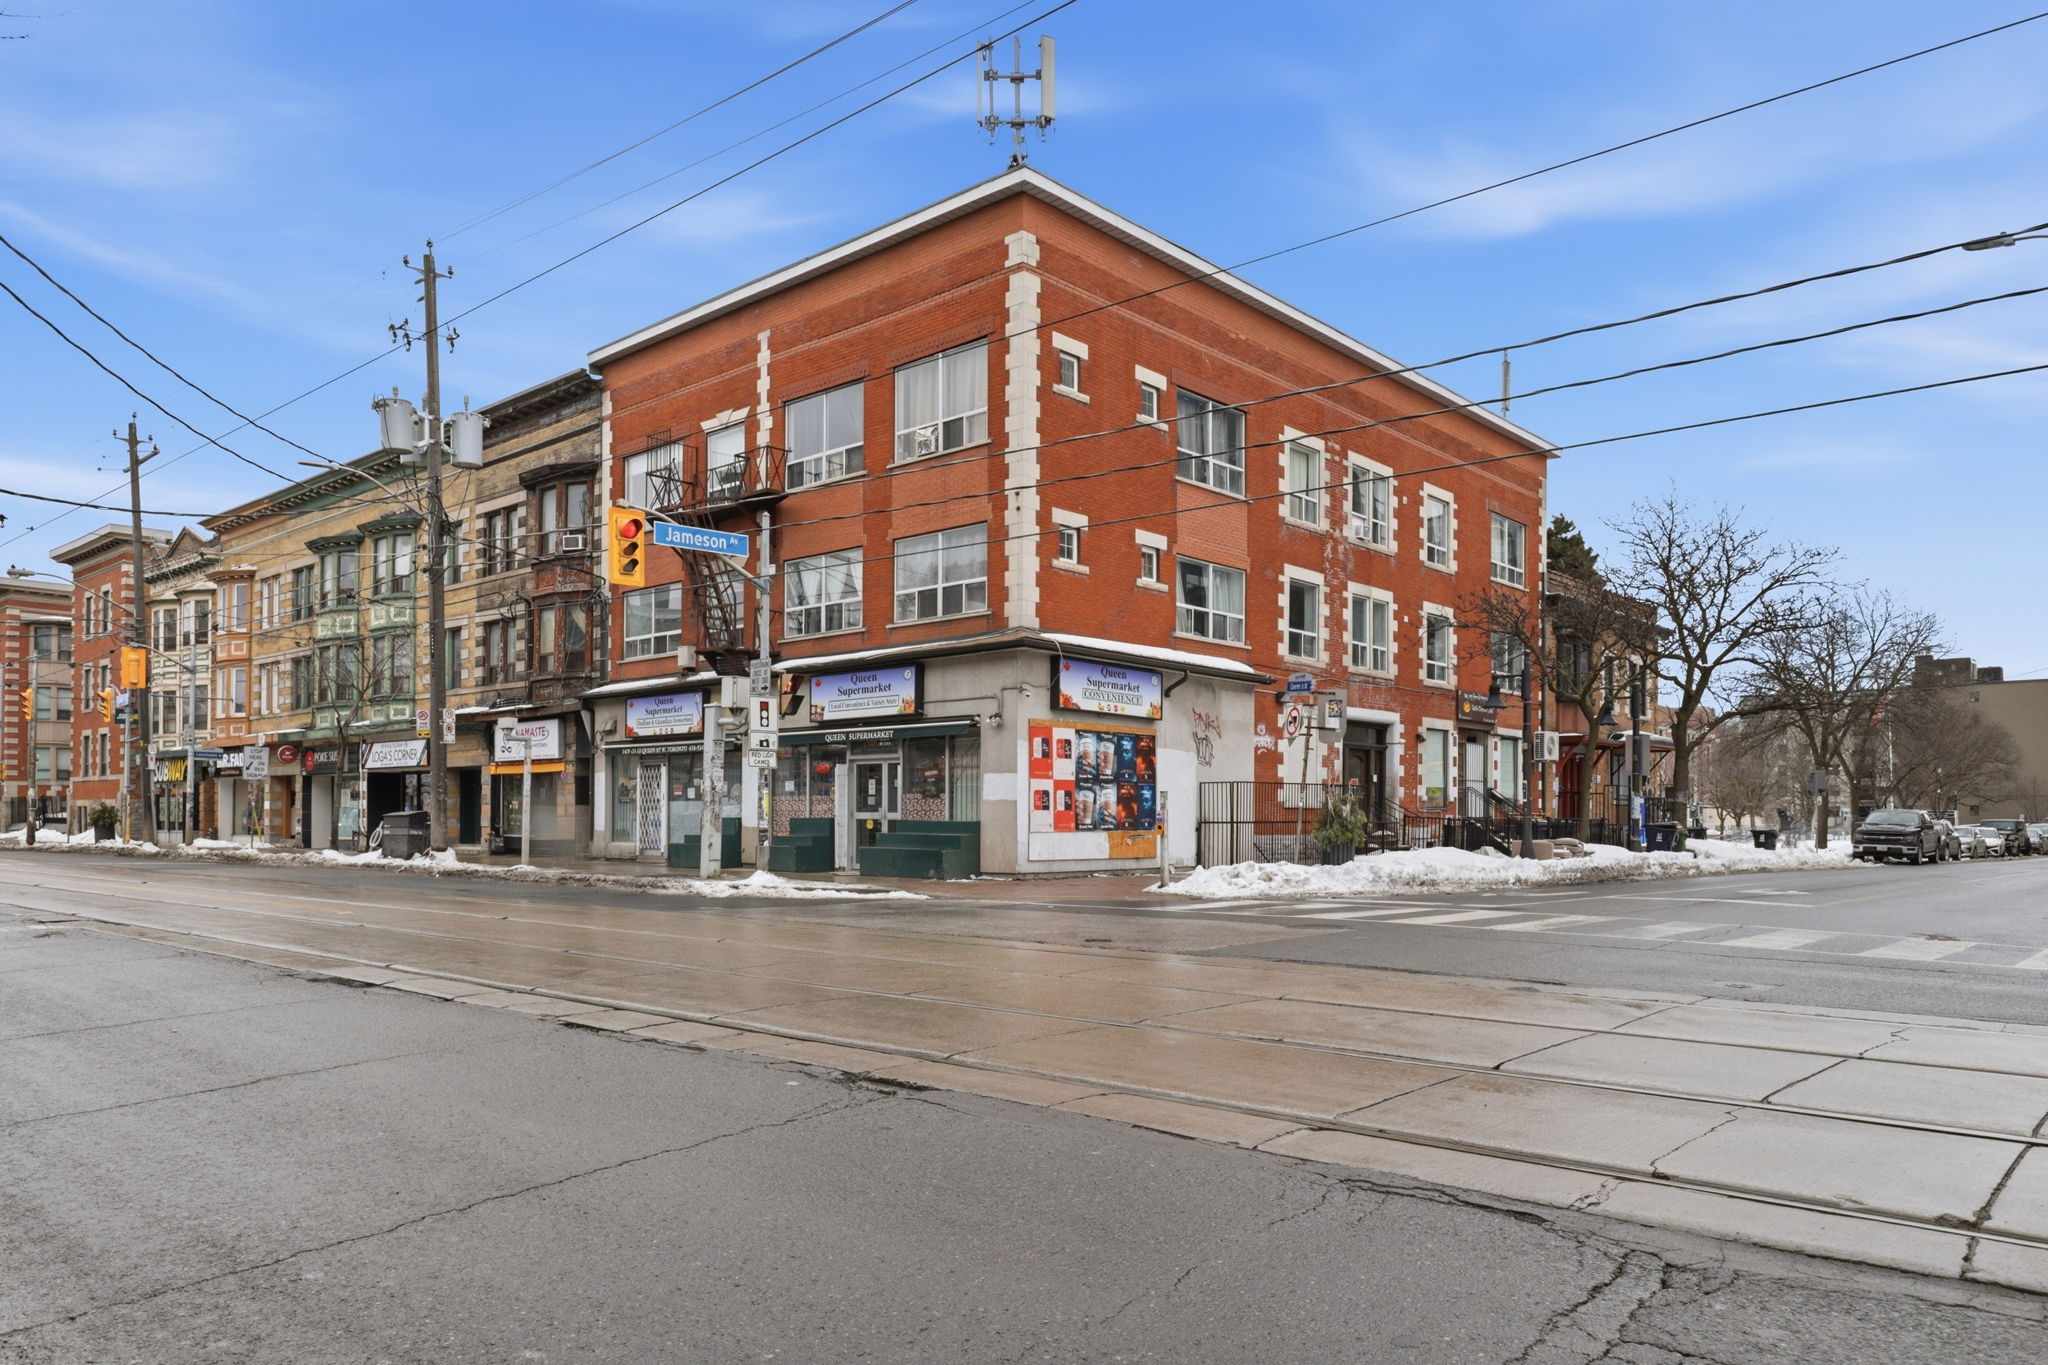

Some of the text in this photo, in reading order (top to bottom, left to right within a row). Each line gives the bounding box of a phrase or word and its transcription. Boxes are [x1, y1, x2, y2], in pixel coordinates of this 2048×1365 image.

[665, 527, 739, 549] Jameson Av
[850, 673, 877, 685] Queen
[1101, 665, 1127, 680] Queen
[837, 683, 892, 698] Supermarket
[1086, 676, 1140, 693] Supermarket
[654, 697, 674, 706] Queen
[1083, 689, 1143, 705] CONVENIENCE
[644, 706, 683, 717] Supermarket
[515, 726, 546, 737] NAMASTE
[824, 730, 894, 742] QUEEN SUPERMARKET
[314, 751, 328, 763] POKE
[371, 749, 417, 763] LOGA'S CORNER
[154, 759, 188, 782] SUBWAY
